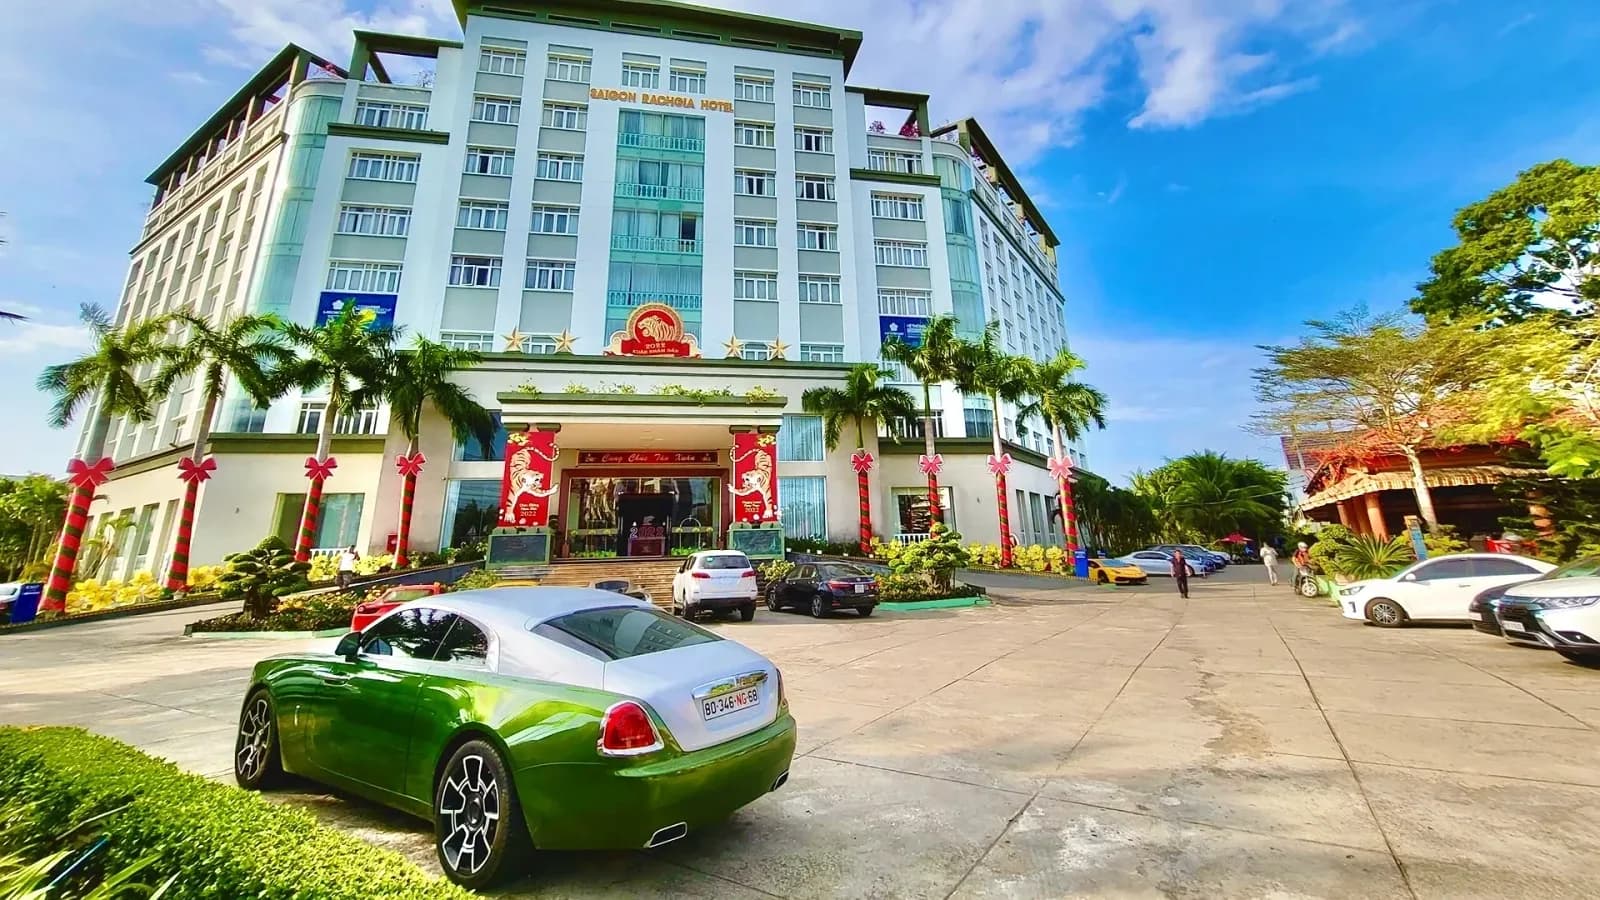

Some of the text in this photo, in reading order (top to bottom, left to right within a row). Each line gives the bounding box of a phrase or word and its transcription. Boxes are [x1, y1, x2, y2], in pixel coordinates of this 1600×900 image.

[590, 88, 734, 113] SAIGON RACHGIA HOTEL
